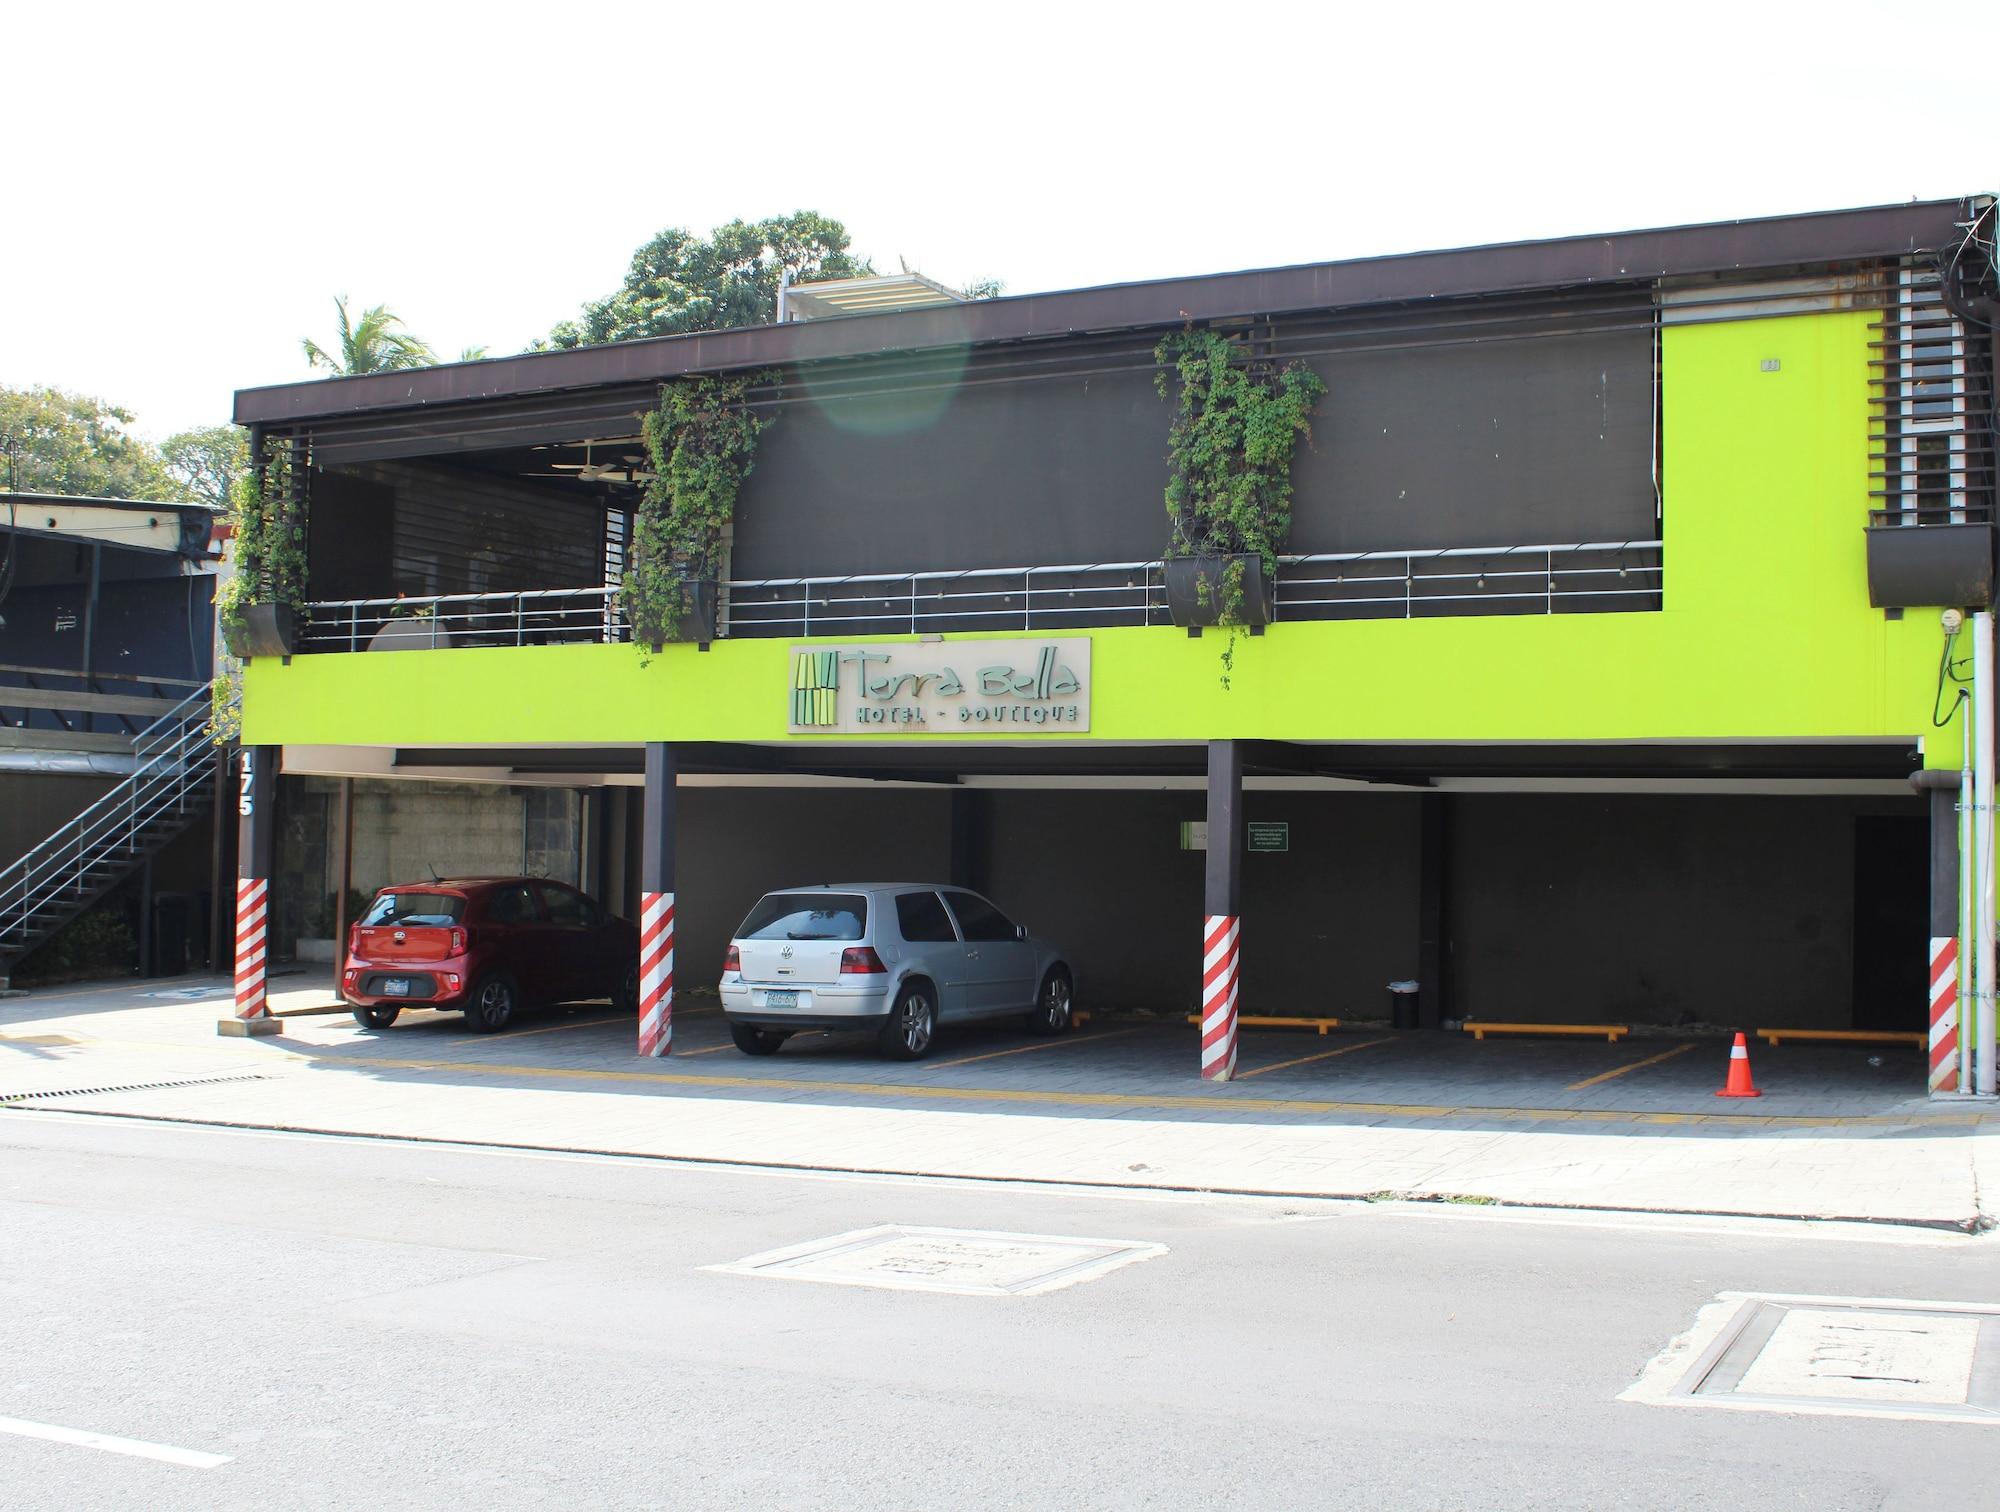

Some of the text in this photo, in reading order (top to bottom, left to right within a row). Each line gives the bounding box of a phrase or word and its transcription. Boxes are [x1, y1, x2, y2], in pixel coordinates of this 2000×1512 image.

[841, 646, 1081, 700] Terra Bella
[857, 706, 926, 723] HOTEL
[959, 705, 1079, 723] BOUTIQUE
[239, 751, 254, 816] 175
